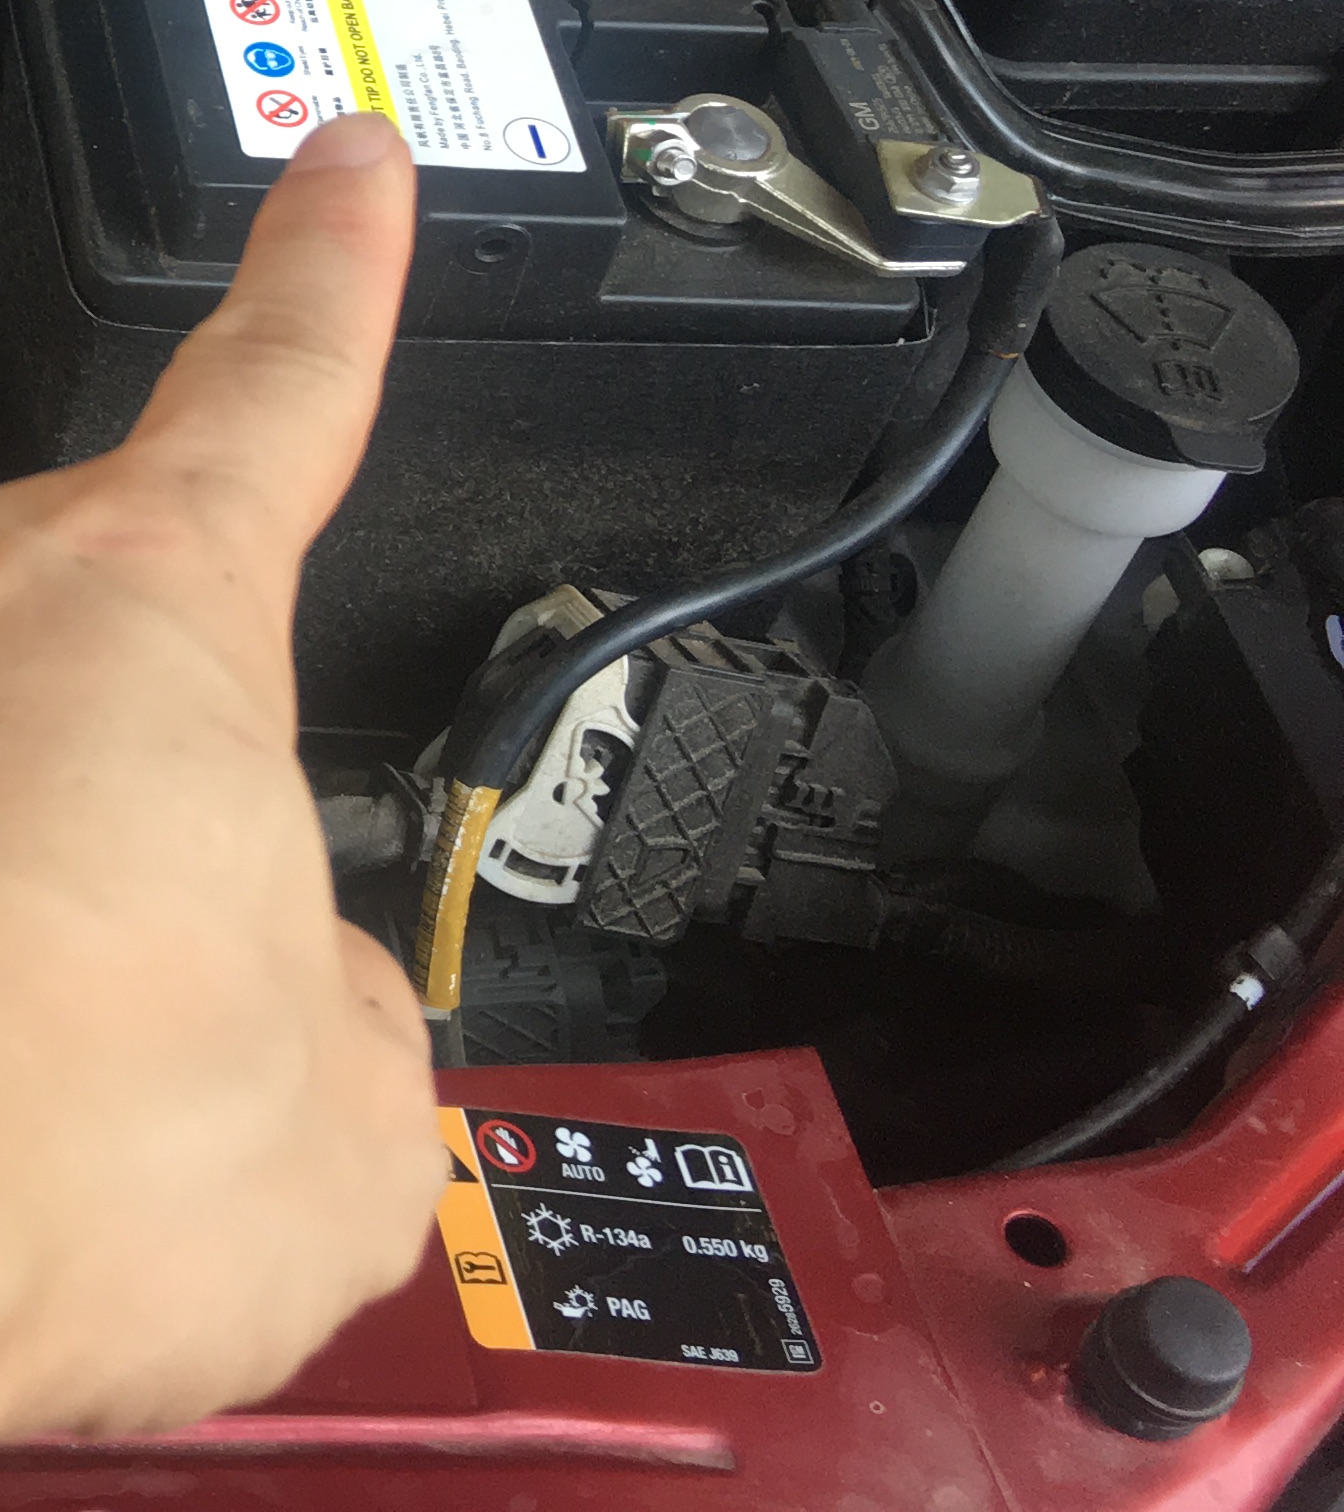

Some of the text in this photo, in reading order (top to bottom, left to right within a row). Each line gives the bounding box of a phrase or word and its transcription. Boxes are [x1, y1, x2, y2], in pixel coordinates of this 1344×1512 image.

[343, 12, 364, 41] OPEN
[438, 12, 456, 35] Hebei
[352, 43, 371, 65] NOT
[420, 84, 442, 115] Fengfan
[430, 116, 446, 126] by
[465, 95, 488, 129] Fuchang
[848, 101, 880, 131] GM
[433, 126, 451, 149] Made
[455, 132, 472, 149] 中国
[477, 132, 494, 151] No.8
[558, 1162, 607, 1182] AUTO
[578, 1223, 772, 1263] R-134a 0.550 kg
[604, 1295, 652, 1321] PAG
[679, 1344, 740, 1363] SAE J639
